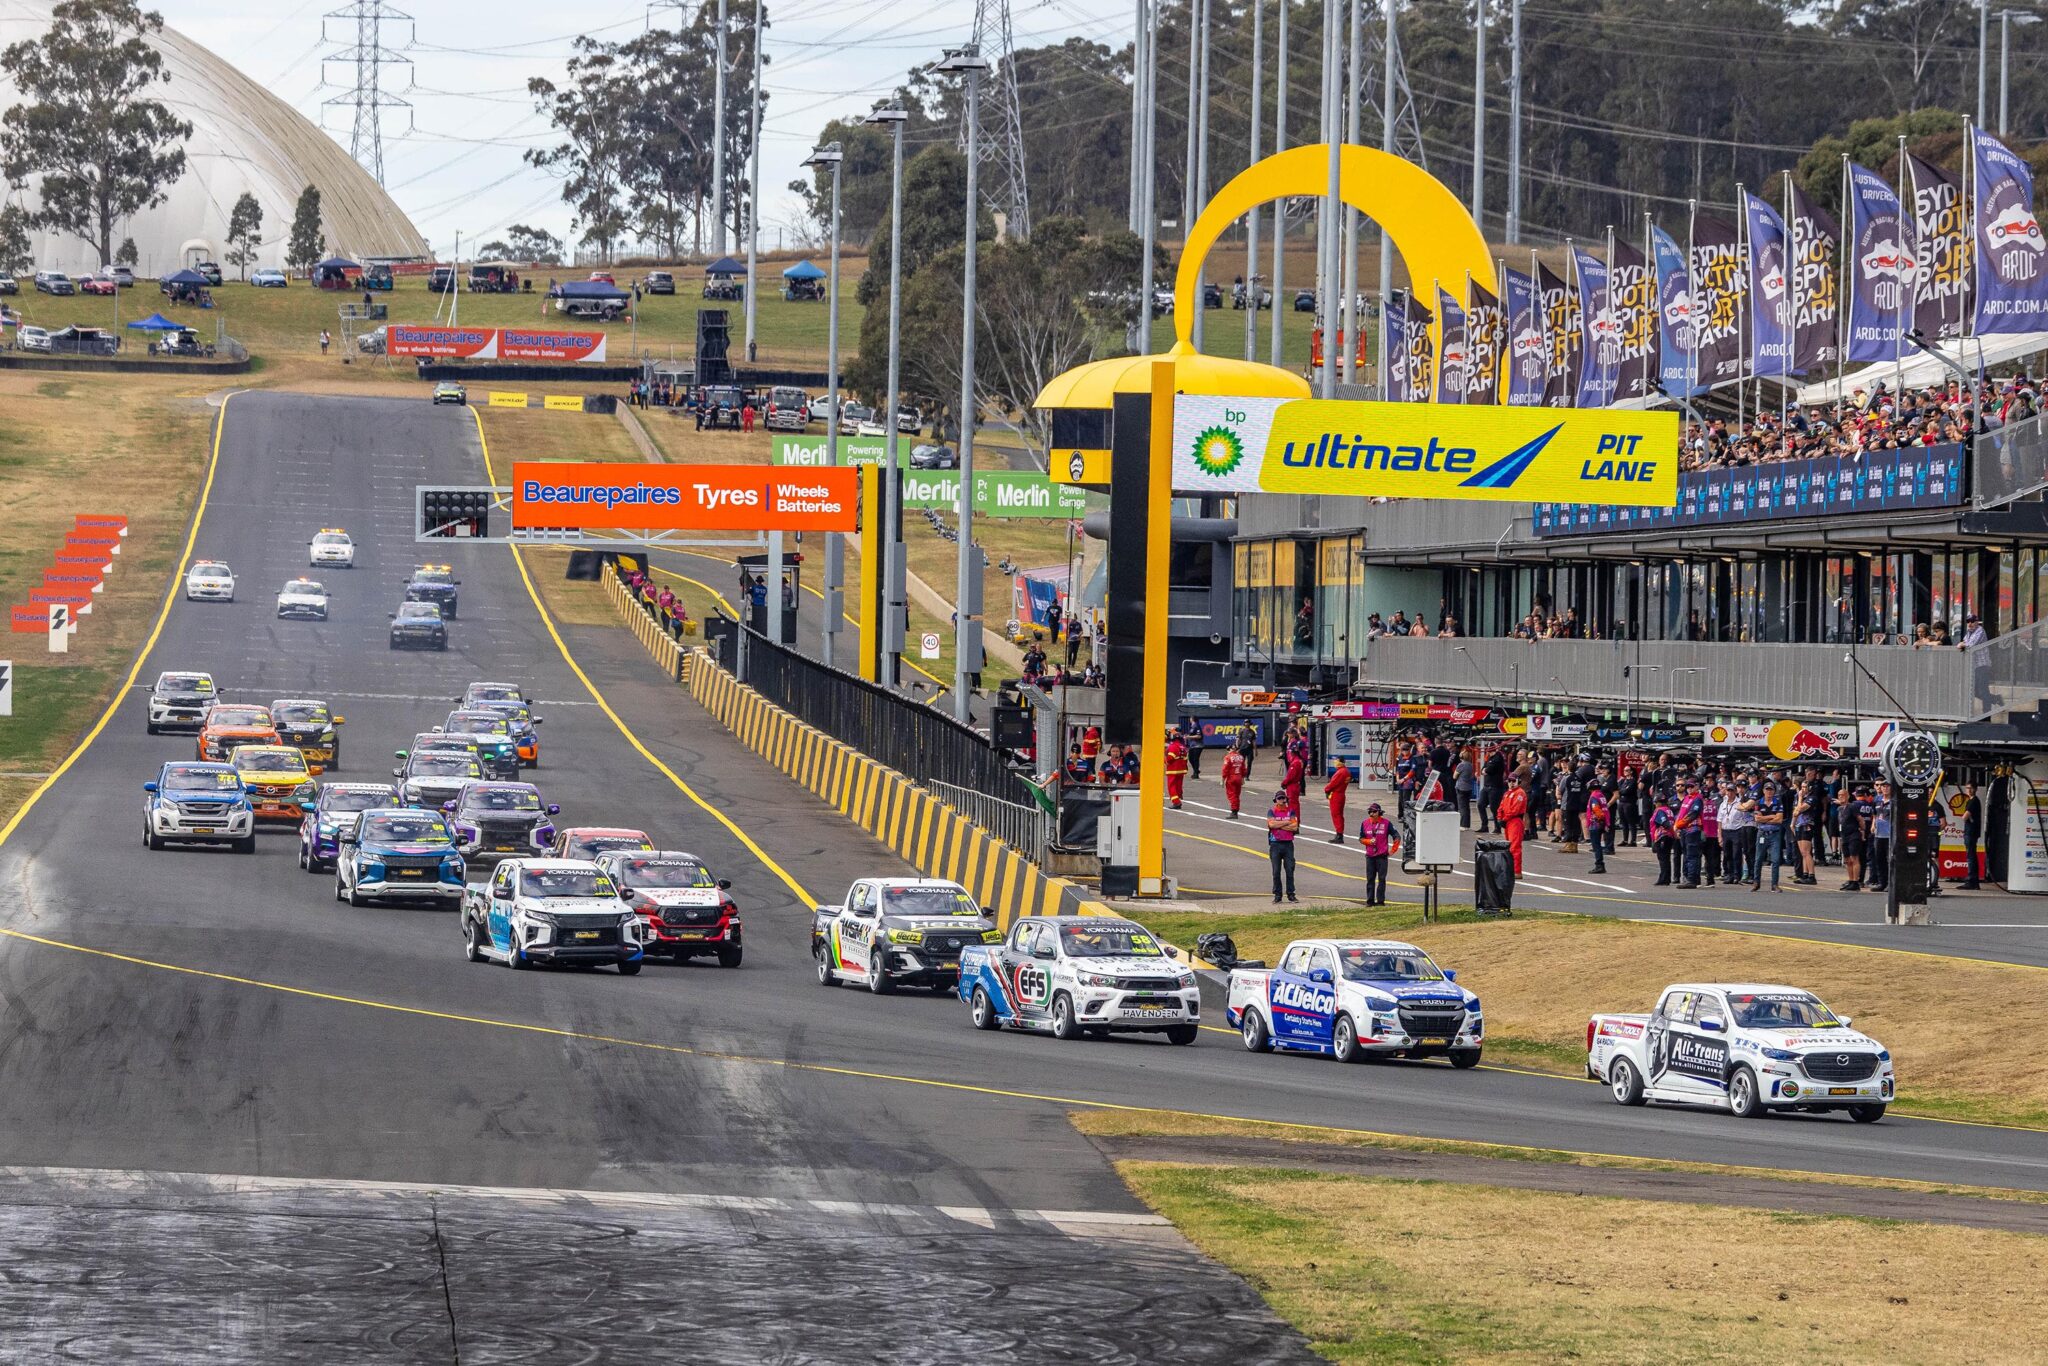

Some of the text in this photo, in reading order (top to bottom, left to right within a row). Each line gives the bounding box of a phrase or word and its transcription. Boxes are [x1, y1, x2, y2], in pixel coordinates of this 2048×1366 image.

[2002, 250, 2037, 281] ARDC
[395, 328, 483, 344] Beaurepaires
[504, 330, 592, 349] Beaurepaires
[1226, 408, 1246, 425] bp
[1283, 433, 1476, 473] ultimate
[1597, 434, 1643, 455] PIT
[783, 444, 884, 465] Merli Powering
[1580, 460, 1656, 482] LANE
[523, 480, 758, 510] Beaurepaires Tyres
[777, 484, 830, 498] Wheels
[997, 483, 1050, 507] Merlin
[777, 500, 841, 513] Batteries
[926, 638, 936, 646] 40
[1215, 725, 1258, 735] PIRTK
[1733, 732, 1767, 740] V-Power
[896, 931, 920, 942] Hertz
[985, 932, 1001, 943] Hertz
[1131, 935, 1151, 944] 58
[1020, 971, 1045, 997] EFS
[1273, 981, 1334, 1013] ACDelco
[1672, 1038, 1725, 1061] All-Trans
[1735, 1037, 1760, 1050] TFS
